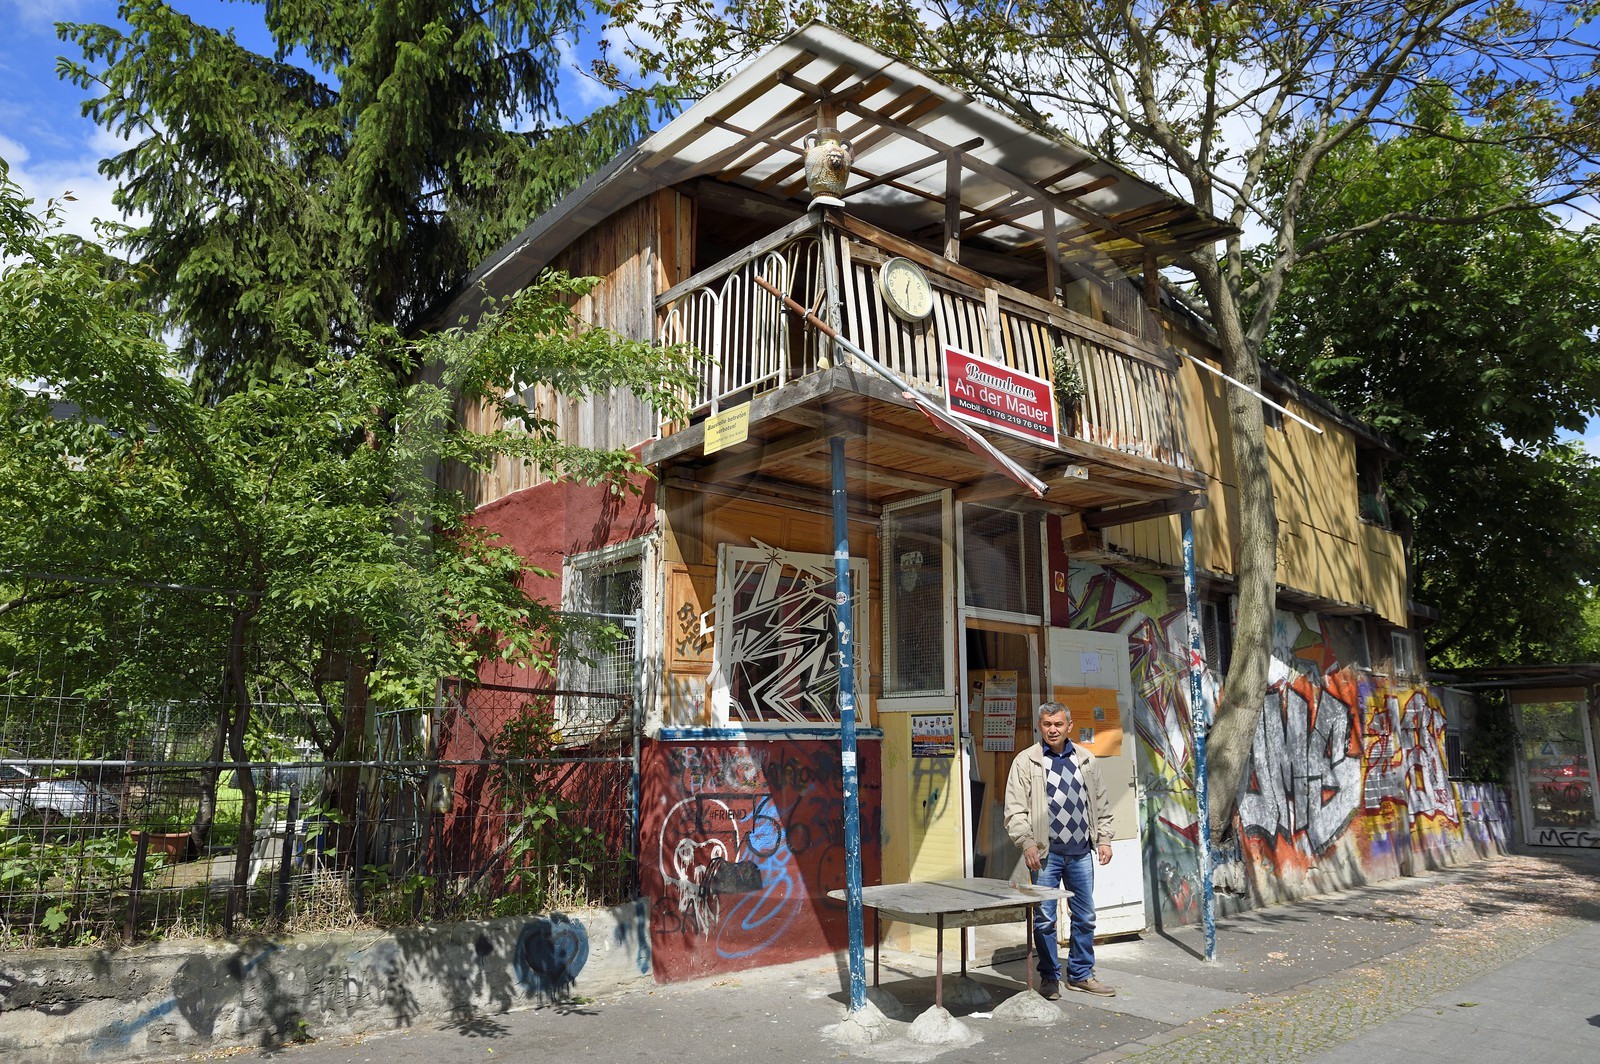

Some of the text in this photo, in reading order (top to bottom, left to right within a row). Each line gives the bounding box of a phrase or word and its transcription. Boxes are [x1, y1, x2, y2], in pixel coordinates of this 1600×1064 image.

[965, 362, 1036, 400] Baumhaus
[955, 377, 1049, 423] An der Mauer
[986, 409, 1006, 420] 0176
[1007, 415, 1022, 425] 219
[1023, 419, 1033, 428] 76
[1033, 423, 1048, 433] 612
[709, 808, 747, 821] #FRIEND
